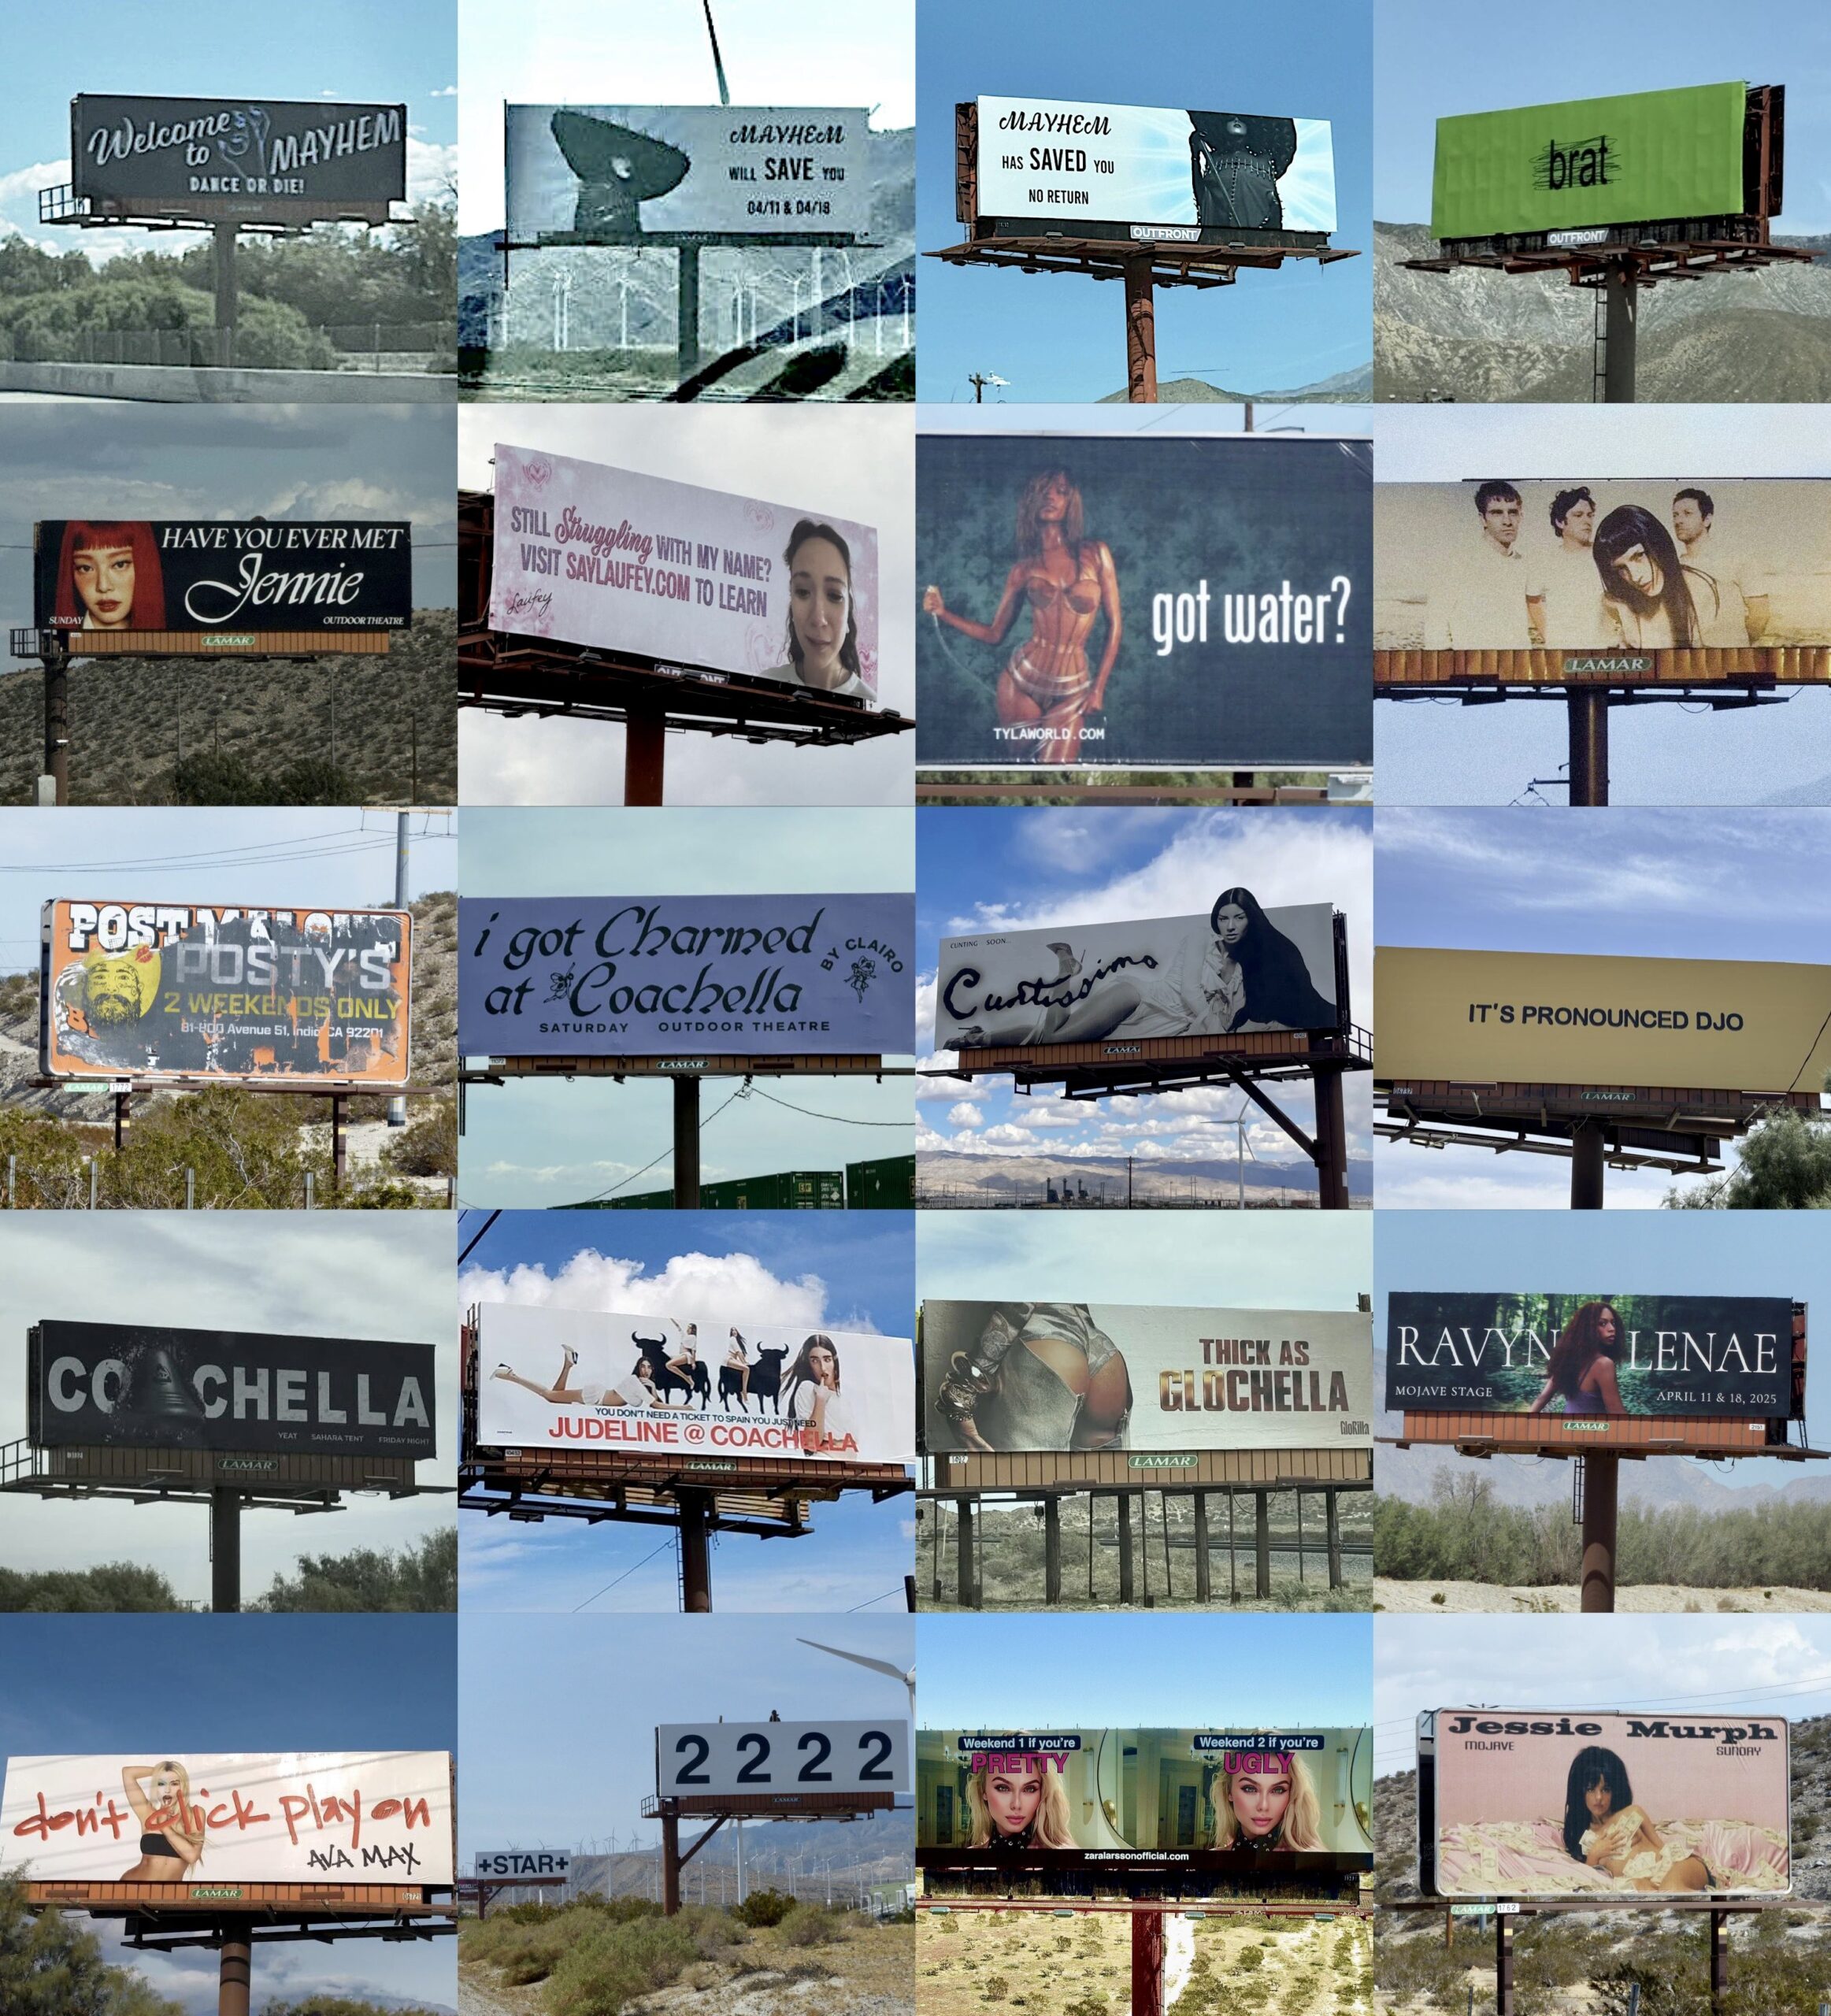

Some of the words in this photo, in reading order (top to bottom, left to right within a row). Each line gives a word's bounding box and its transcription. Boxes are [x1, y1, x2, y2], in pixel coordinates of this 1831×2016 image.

[999, 111, 1112, 136] MAYHEM
[88, 112, 232, 165] Welcome
[186, 141, 210, 166] to
[270, 110, 402, 176] MAYHEM
[730, 124, 845, 145] MAYHEM
[729, 166, 757, 181] WILL
[765, 158, 814, 181] SAVE
[822, 166, 845, 181] YOU
[1002, 155, 1023, 171] HAS
[1029, 148, 1087, 174] SAVED
[1093, 159, 1114, 175] YOU
[1549, 135, 1608, 190] brat
[190, 176, 240, 192] DANCE
[246, 177, 267, 193] OR
[273, 178, 304, 194] DIE!
[748, 200, 780, 214] 04/11
[784, 201, 792, 214] &
[1029, 188, 1043, 203] NO
[1047, 190, 1089, 206] RETURN
[1133, 227, 1197, 239] OUTFRONT
[1549, 229, 1607, 244] OUTFRONT
[162, 528, 228, 549] HAVE
[233, 528, 288, 549] YOU
[288, 528, 349, 549] EVER
[350, 528, 404, 549] MET
[511, 506, 550, 537] STILL
[555, 505, 653, 564] Struggling
[656, 534, 692, 566] WITH
[697, 543, 719, 571] MY
[723, 550, 772, 582] NAME?
[185, 553, 364, 623] Jennie
[521, 544, 562, 576] VISIT
[566, 553, 690, 602] SAYLAUFEY.COM
[695, 578, 713, 606] TO
[719, 585, 767, 617] LEARN
[1153, 580, 1210, 656] got
[1225, 576, 1351, 644] water?
[205, 637, 250, 646] LAMAR
[1571, 658, 1644, 671] LAMAR
[994, 727, 1105, 740] TYLAWORLD.COM
[69, 903, 189, 951] POST
[474, 912, 499, 957] i
[503, 919, 585, 970] got
[595, 905, 825, 957] Charmed
[951, 940, 978, 949] CUNTING
[820, 949, 841, 972] BY
[846, 938, 903, 973] CLAIRO
[176, 943, 391, 990] POSTY'S
[485, 978, 535, 1015] at
[569, 962, 802, 1017] Coachella
[164, 991, 180, 1013] 2
[189, 992, 331, 1017] WEEKENDS
[337, 997, 402, 1019] ONLY
[539, 1023, 628, 1033] SATURDAY
[658, 1022, 743, 1032] OUTDOOR
[753, 1021, 830, 1032] THEATRE
[1469, 1002, 1514, 1024] IT'S
[1522, 1006, 1689, 1030] PRONOUNCED
[1696, 1012, 1744, 1032] DJO
[228, 1024, 271, 1035] Avenue
[274, 1025, 289, 1036] 51,
[1585, 1092, 1631, 1102] LAMAR
[1199, 1338, 1270, 1366] THICK
[1279, 1340, 1310, 1366] AS
[1396, 1326, 1561, 1369] RAVYN
[1628, 1331, 1777, 1373] LENAE
[1159, 1369, 1350, 1412] GLOCHELLA
[1395, 1386, 1449, 1398] MOJAVE
[1451, 1387, 1492, 1398] STAGE
[1657, 1392, 1696, 1403] APRIL
[1702, 1392, 1711, 1403] 11
[1716, 1393, 1725, 1403] &
[1730, 1393, 1745, 1405] 18,
[1751, 1393, 1777, 1404] 2025
[595, 1407, 614, 1417] YOU
[617, 1408, 646, 1418] DON'T
[647, 1410, 670, 1419] NEED
[680, 1413, 710, 1421] TICKET
[725, 1415, 751, 1424] SPAIN
[752, 1417, 770, 1425] YOU
[772, 1418, 794, 1426] JUST
[795, 1419, 817, 1428] NEED
[549, 1418, 678, 1444] JUDELINE
[684, 1424, 705, 1445] @
[710, 1425, 858, 1453] COACHELLA
[221, 1461, 273, 1470] LAMAR
[691, 1462, 732, 1470] LAMAR
[1133, 1455, 1192, 1467] LAMAR
[1448, 1717, 1603, 1736] Jessie
[1626, 1721, 1778, 1744] Murph
[964, 1737, 1016, 1749] Weekend
[1018, 1738, 1025, 1749] 1
[1028, 1737, 1038, 1749] if
[1040, 1737, 1076, 1752] you're
[1199, 1736, 1255, 1749] Weekend
[1257, 1737, 1266, 1749] 2
[1268, 1736, 1279, 1749] if
[1280, 1737, 1318, 1752] you're
[1465, 1741, 1514, 1751] MOJAVE
[1716, 1746, 1761, 1756] SUNDAY
[972, 1751, 1070, 1774] PRETTY
[1224, 1751, 1295, 1774] UGLY
[13, 1792, 128, 1841] don't
[144, 1788, 270, 1835] click
[280, 1784, 360, 1848] play
[371, 1797, 430, 1829] on
[307, 1844, 354, 1870] AVA
[363, 1842, 421, 1875] MAX
[1084, 1851, 1189, 1862] zaralarssonofficial.com
[195, 1889, 238, 1899] LAMAR
